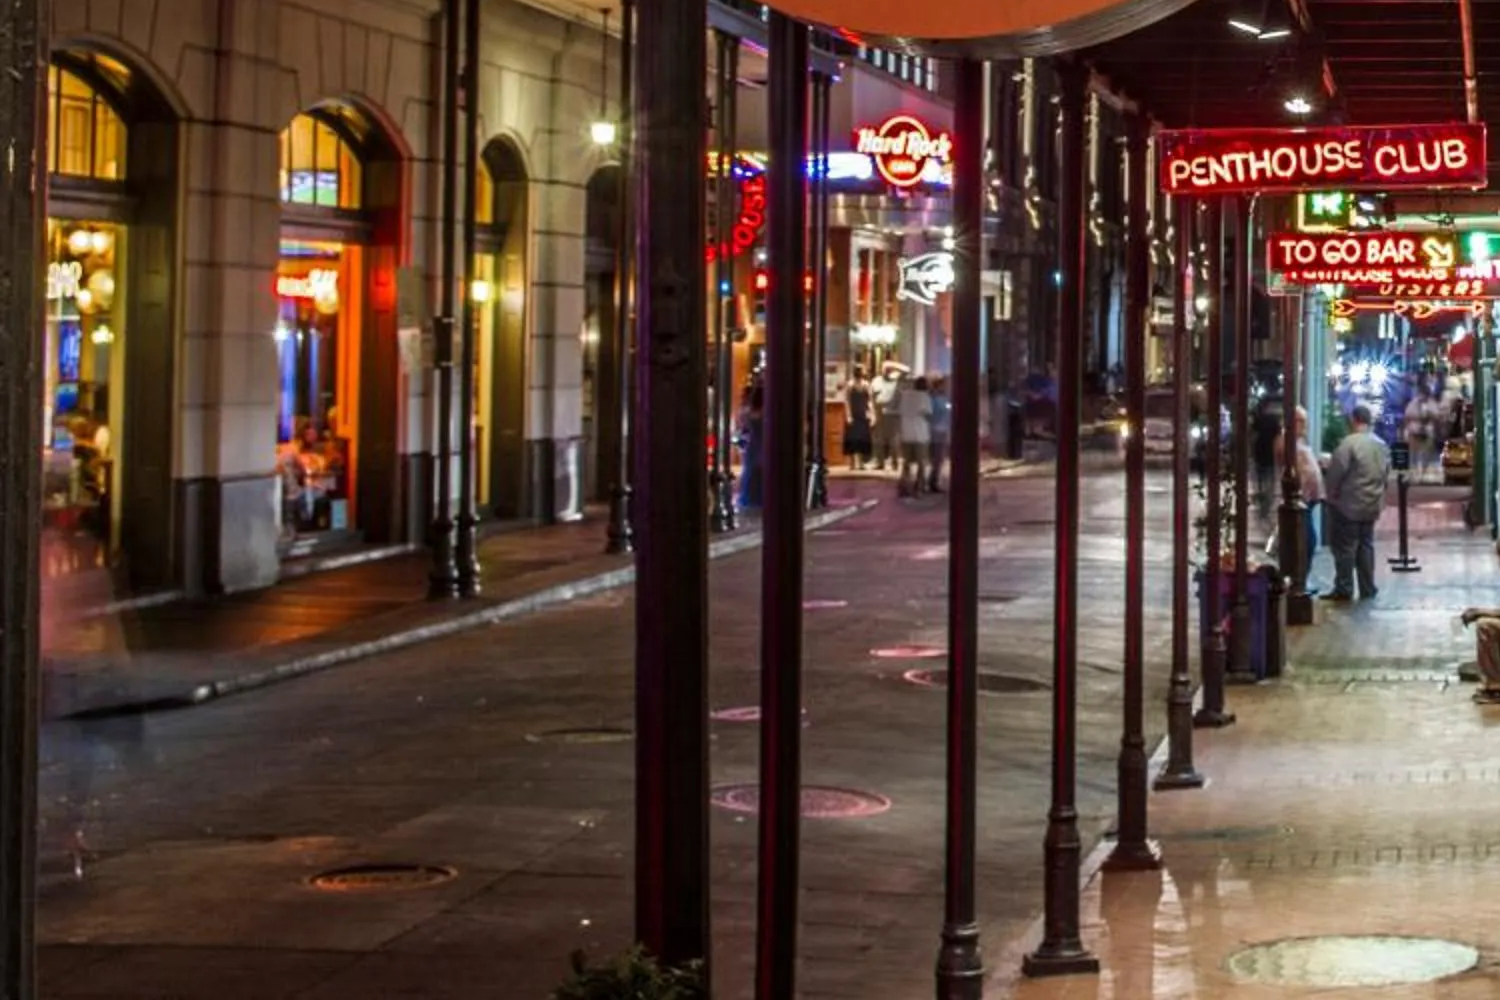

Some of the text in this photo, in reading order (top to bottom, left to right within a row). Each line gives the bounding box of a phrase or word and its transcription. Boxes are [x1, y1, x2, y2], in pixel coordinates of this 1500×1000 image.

[857, 128, 952, 162] Hard Rock
[1169, 138, 1468, 188] PENTHOUSE CLUB
[1279, 238, 1416, 265] TO GO BAR
